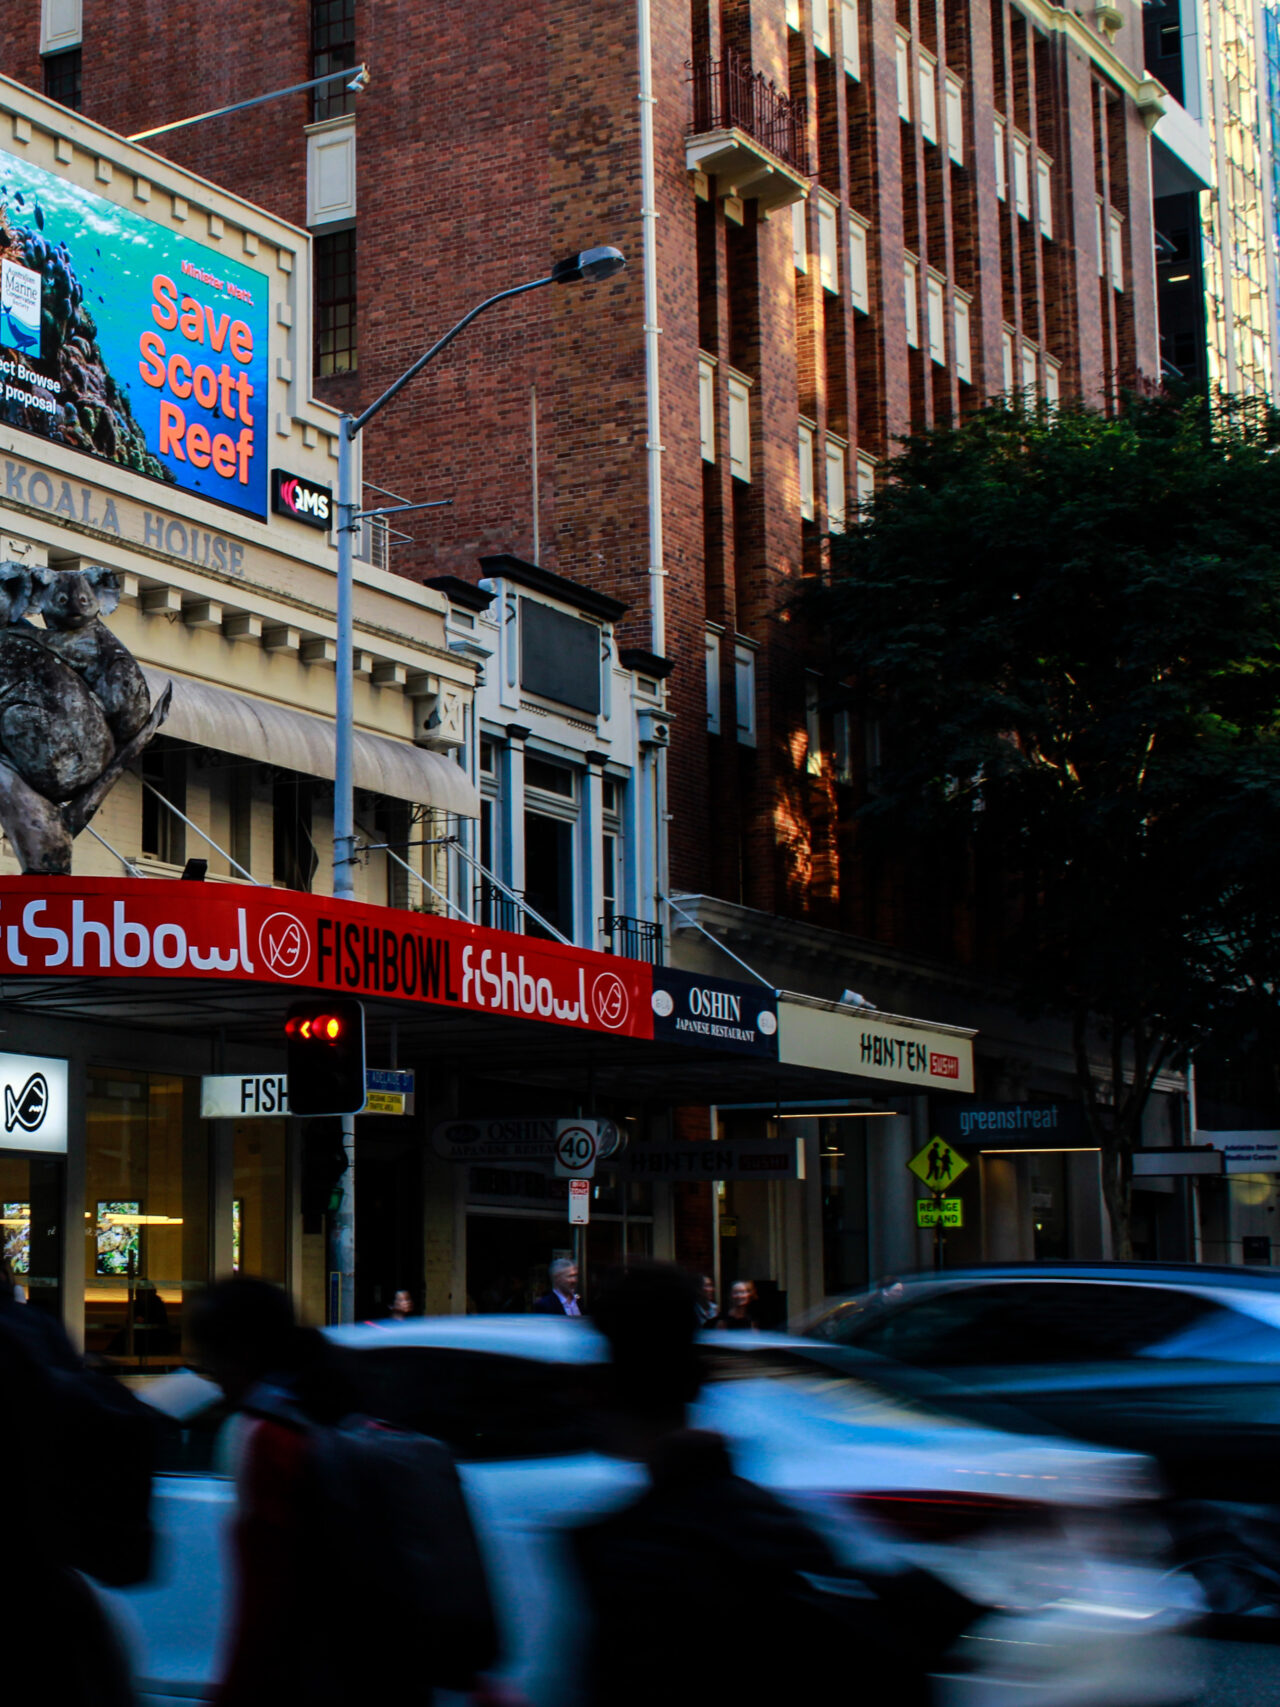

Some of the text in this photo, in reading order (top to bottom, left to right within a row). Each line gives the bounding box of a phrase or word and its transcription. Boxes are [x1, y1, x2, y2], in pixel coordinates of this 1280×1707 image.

[5, 274, 38, 300] Marine
[7, 266, 36, 284] Australian
[180, 259, 255, 306] Minister Watt,
[152, 274, 254, 364] Save
[17, 364, 61, 394] Browse
[139, 330, 255, 427] Scott
[5, 384, 57, 415] proposal
[159, 399, 255, 485] Reef
[4, 460, 246, 577] KOALA HOUSE
[316, 918, 458, 1002] FISHBOWL
[689, 987, 741, 1022] OSHIN
[675, 1018, 710, 1035] JAPANESE
[711, 1024, 755, 1043] RESTAURANT
[860, 1033, 958, 1077] HONTEN SUSHI
[241, 1078, 288, 1113] FISH
[960, 1104, 1059, 1136] greenstreat
[561, 1138, 590, 1159] 40
[921, 1214, 958, 1224] ISLAND
